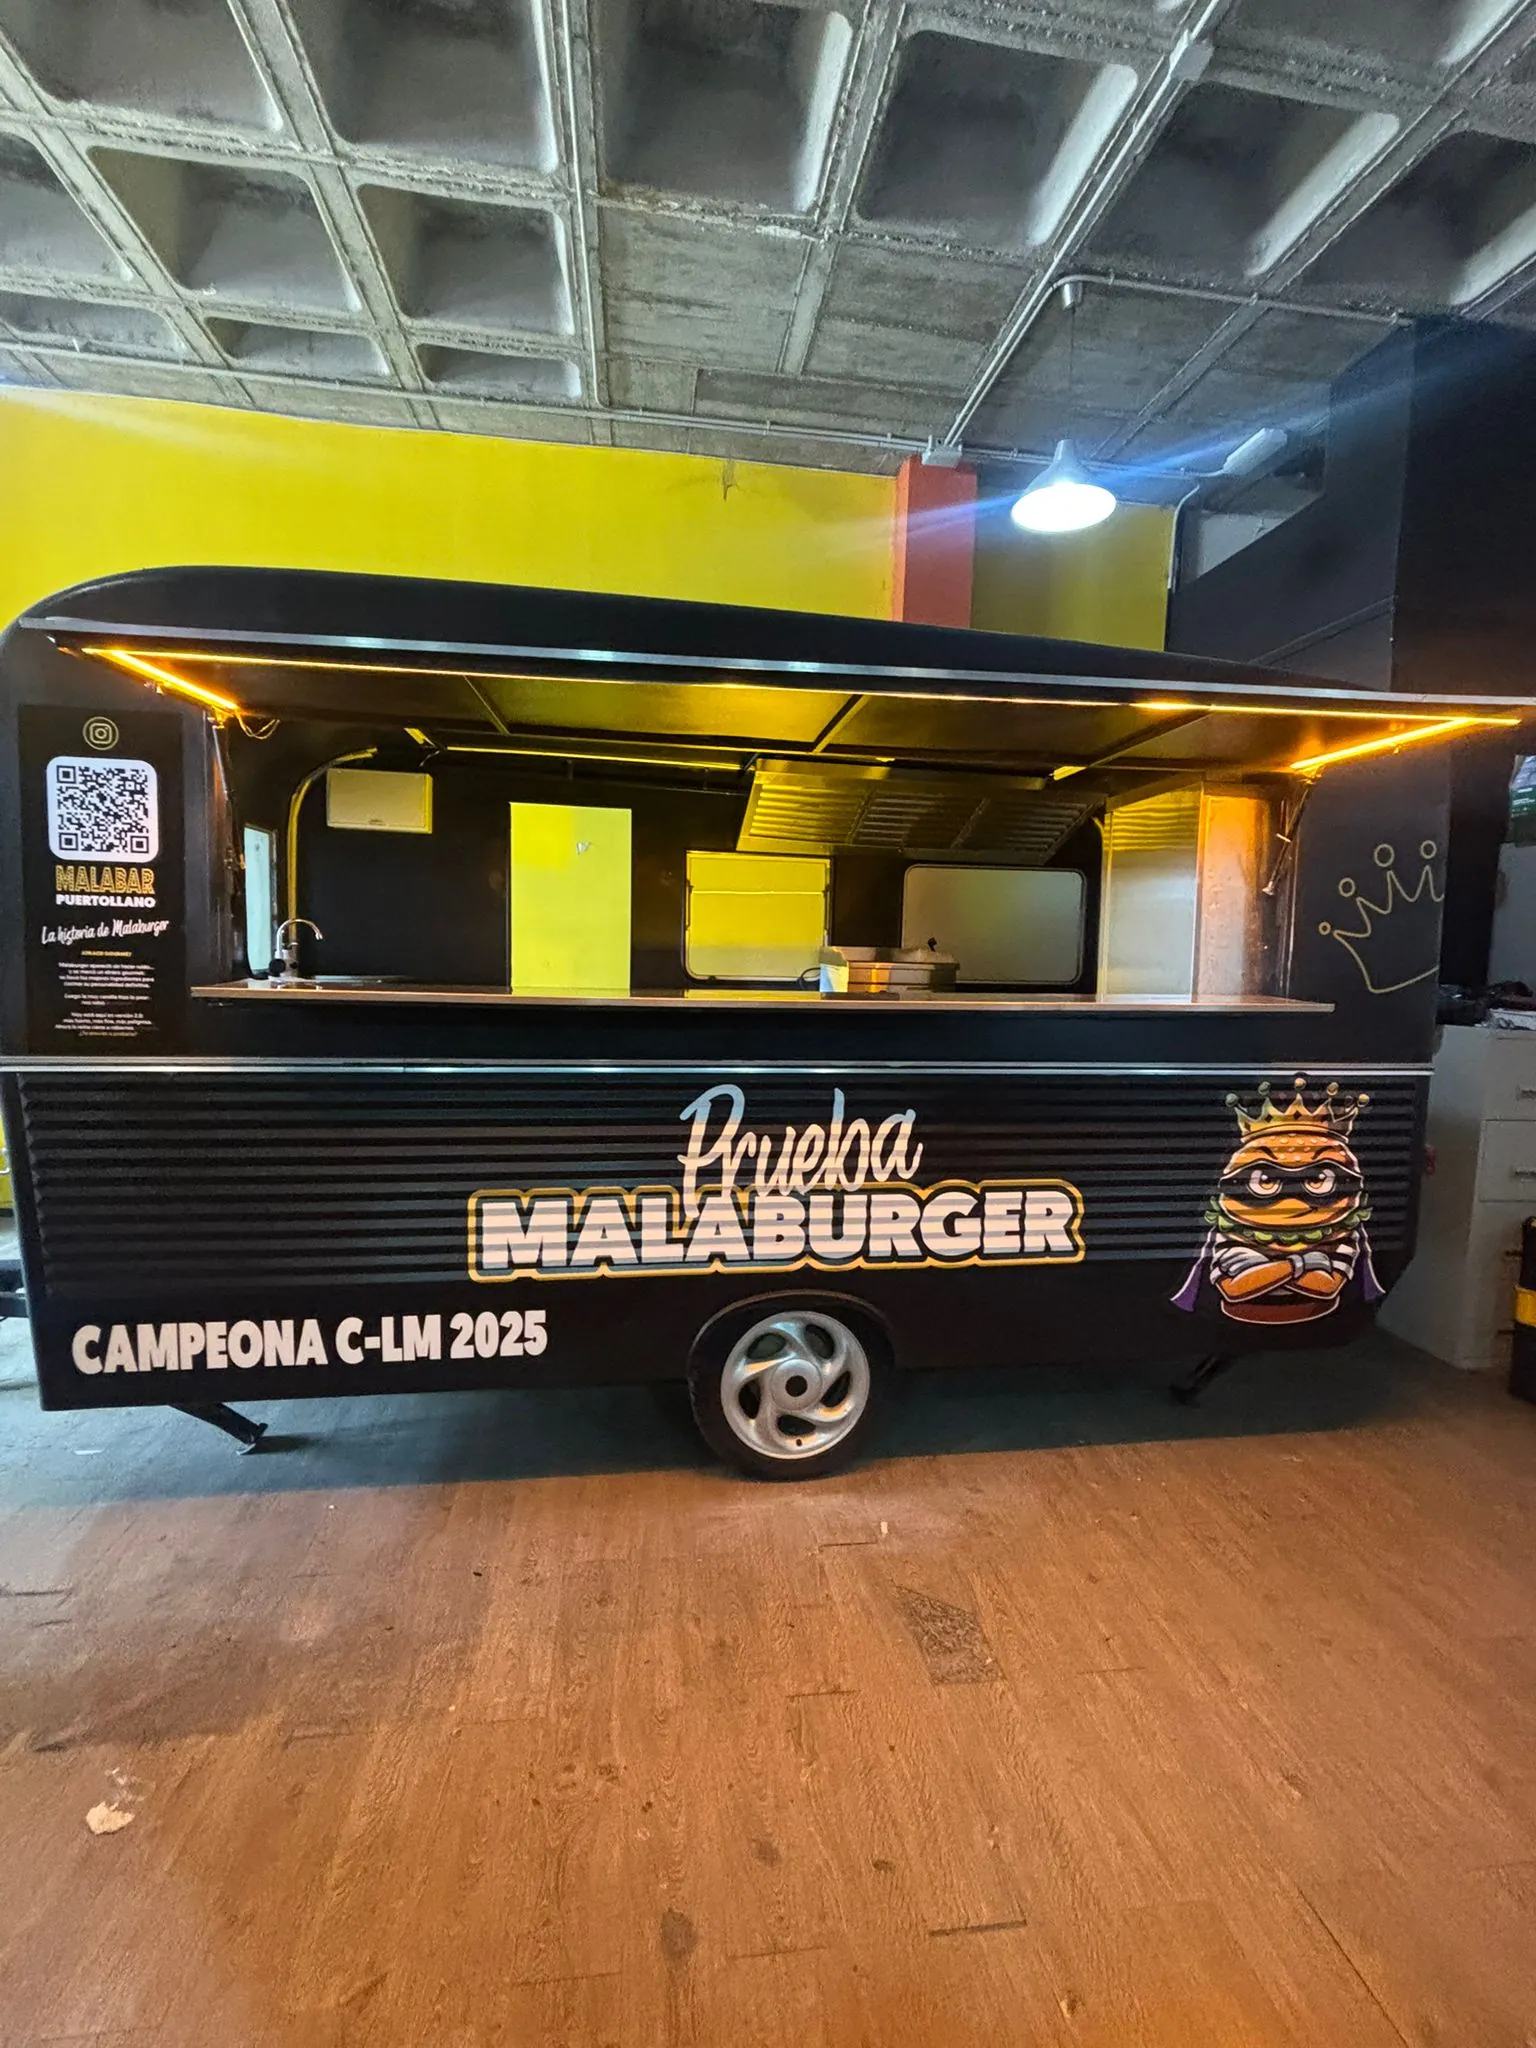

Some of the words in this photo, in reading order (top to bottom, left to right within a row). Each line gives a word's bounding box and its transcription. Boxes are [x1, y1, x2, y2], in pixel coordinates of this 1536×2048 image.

[55, 865, 155, 894] MALABAR
[56, 894, 156, 908] PUERTOLLANO
[42, 926, 56, 944] La
[58, 925, 96, 945] historia
[97, 922, 110, 937] de
[111, 919, 169, 937] Malaburger
[677, 1083, 923, 1219] Prueba
[481, 1191, 1076, 1268] MALABURGER
[72, 1321, 328, 1375] CAMPEONA
[335, 1314, 441, 1366] C-LM
[450, 1310, 548, 1360] 2025
